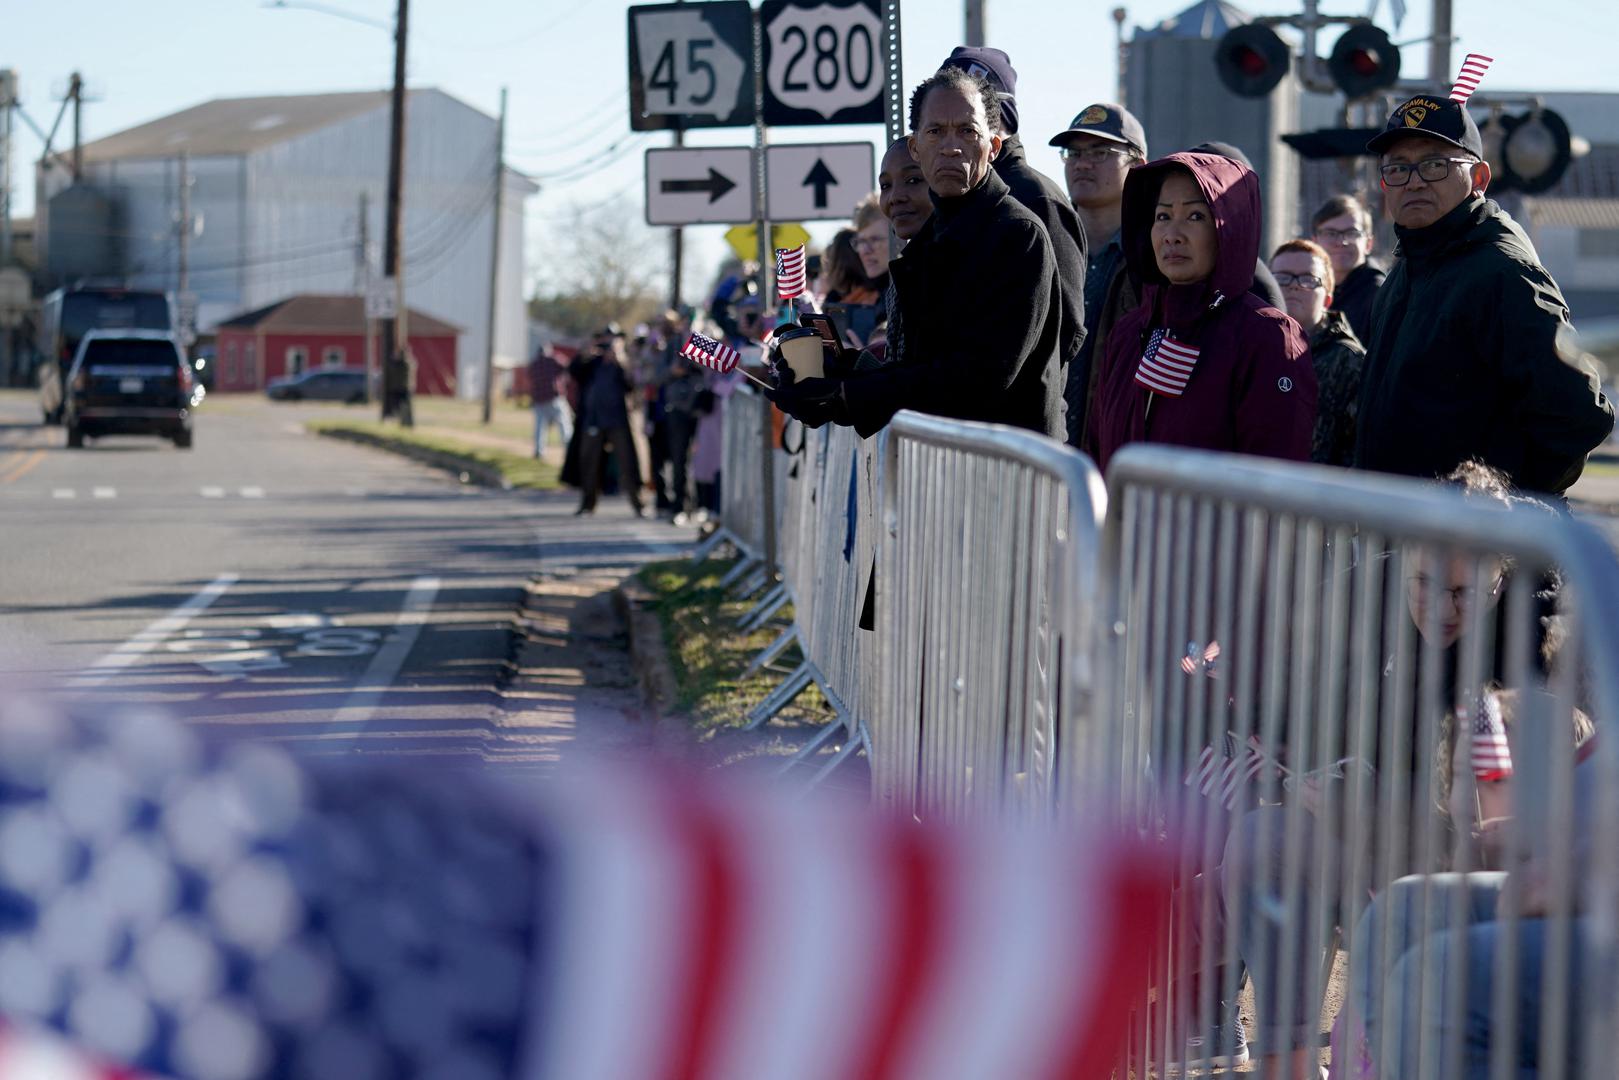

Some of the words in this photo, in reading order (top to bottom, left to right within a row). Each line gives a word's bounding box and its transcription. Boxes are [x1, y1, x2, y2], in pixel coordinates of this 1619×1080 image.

[648, 39, 717, 105] 45
[782, 24, 873, 91] 280
[1404, 98, 1441, 111] CAVALRY
